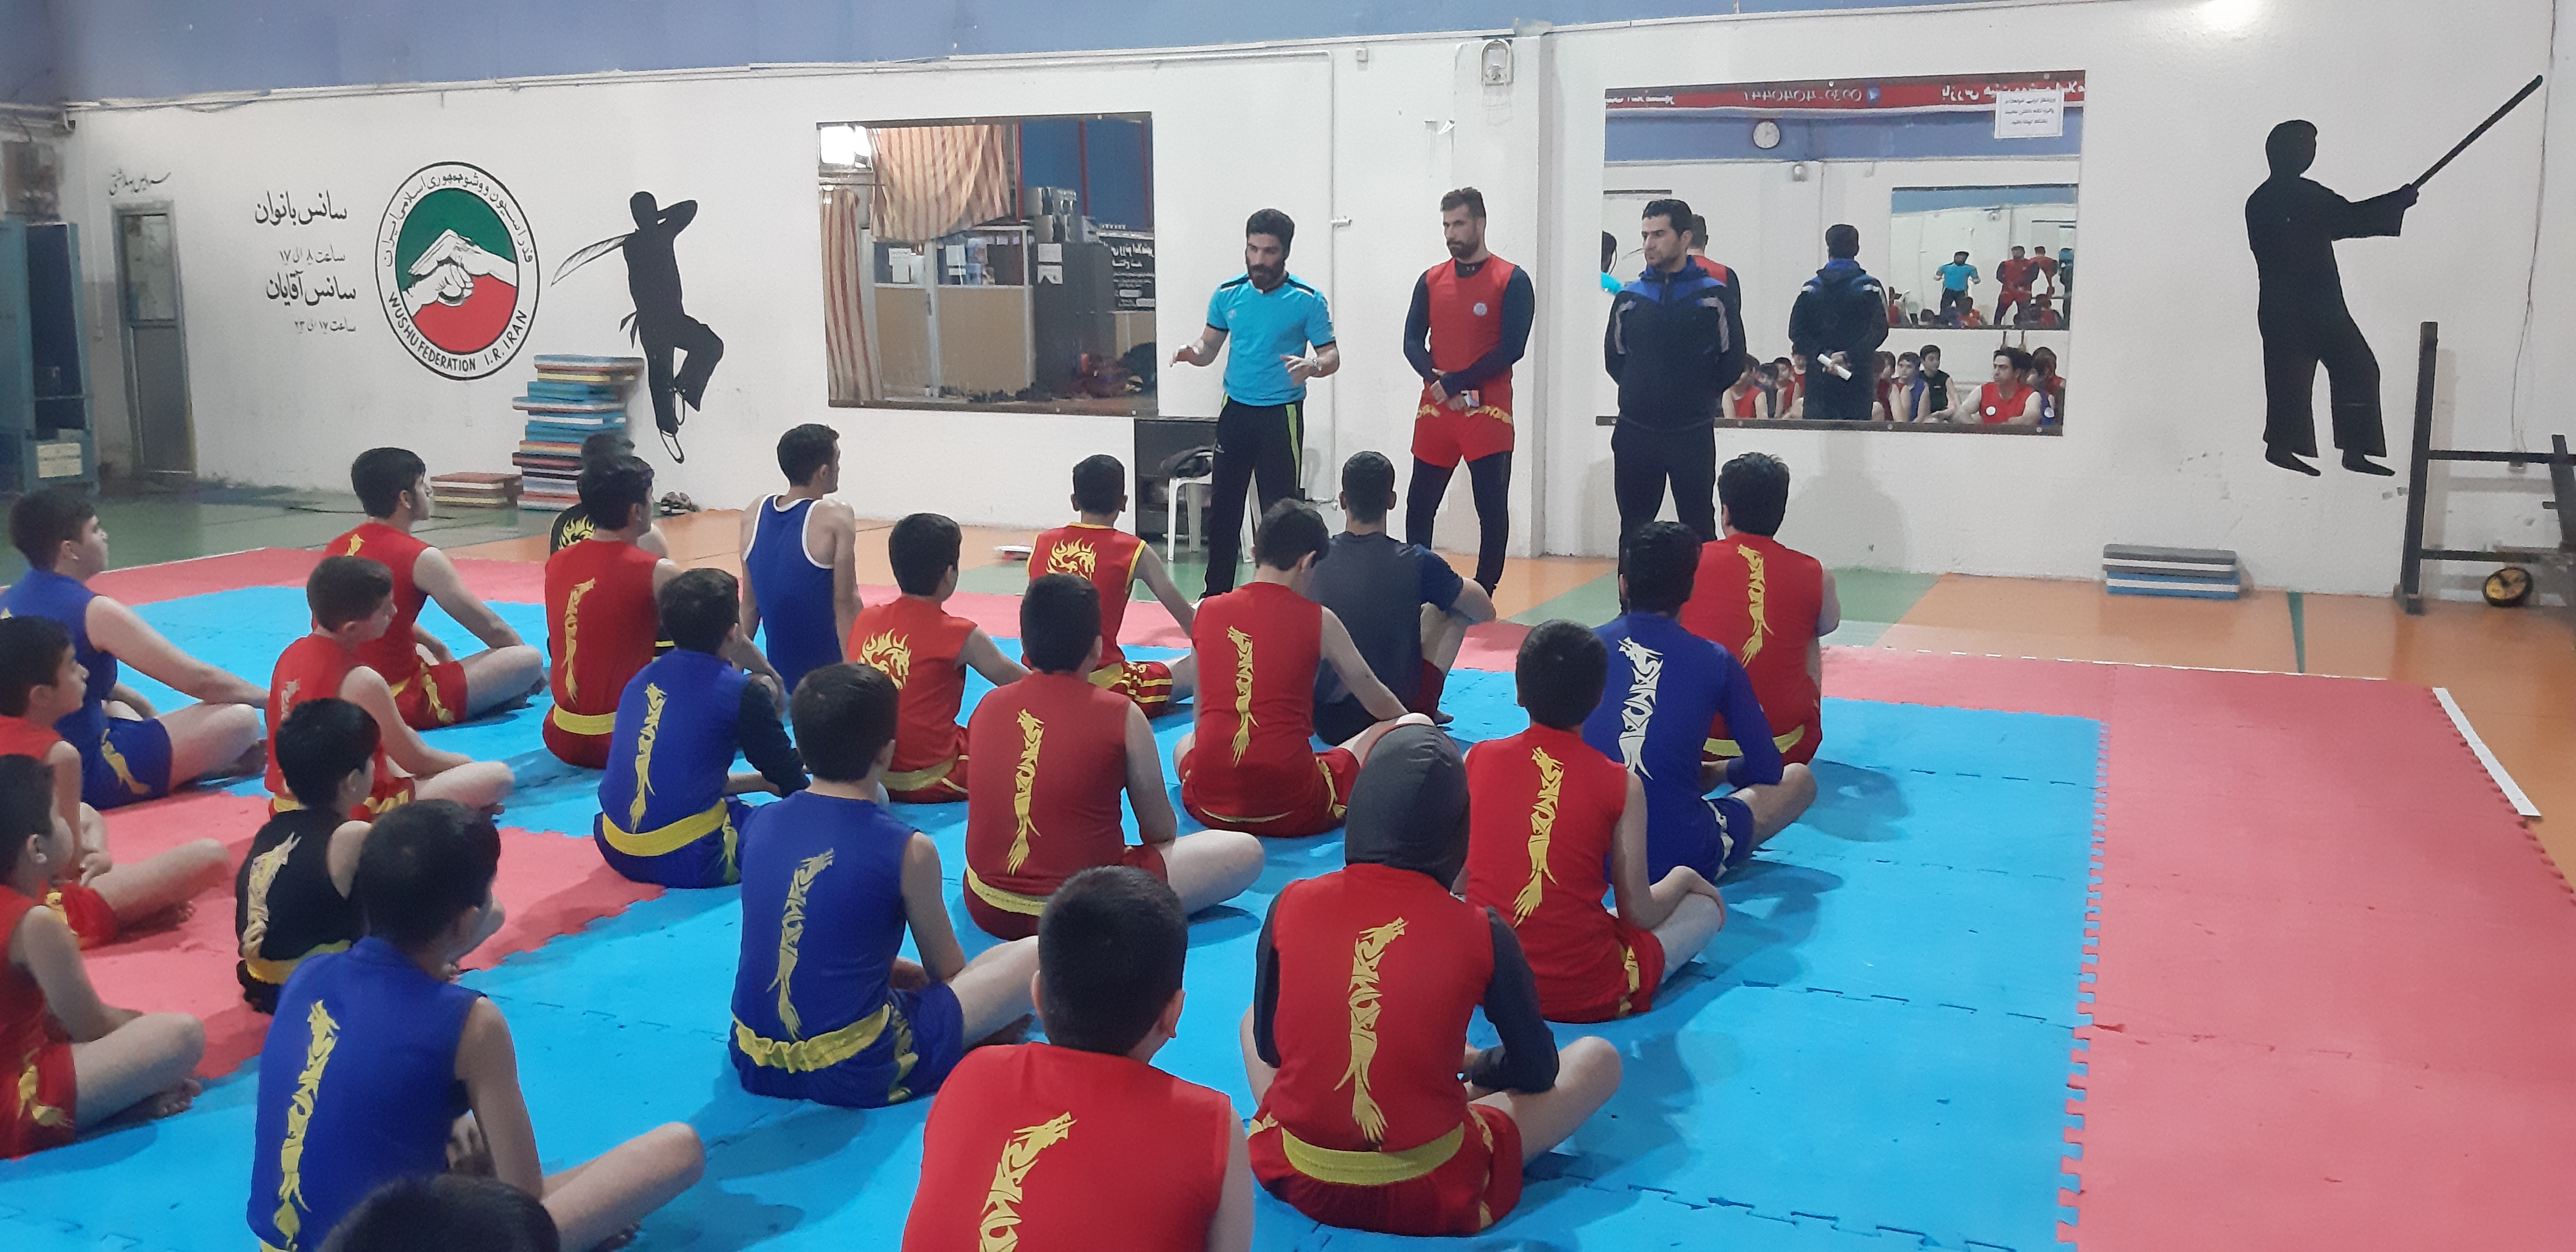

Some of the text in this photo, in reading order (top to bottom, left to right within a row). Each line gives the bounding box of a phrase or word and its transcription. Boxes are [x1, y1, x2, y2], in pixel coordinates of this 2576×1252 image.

[255, 190, 347, 226] سانس بانوان
[315, 244, 346, 263] ساعت
[266, 270, 356, 307] سانس آقایان
[330, 317, 356, 332] ساعت
[388, 292, 419, 346] WUSHU
[418, 340, 476, 372] FEDERATION
[506, 310, 528, 350] IRAN
